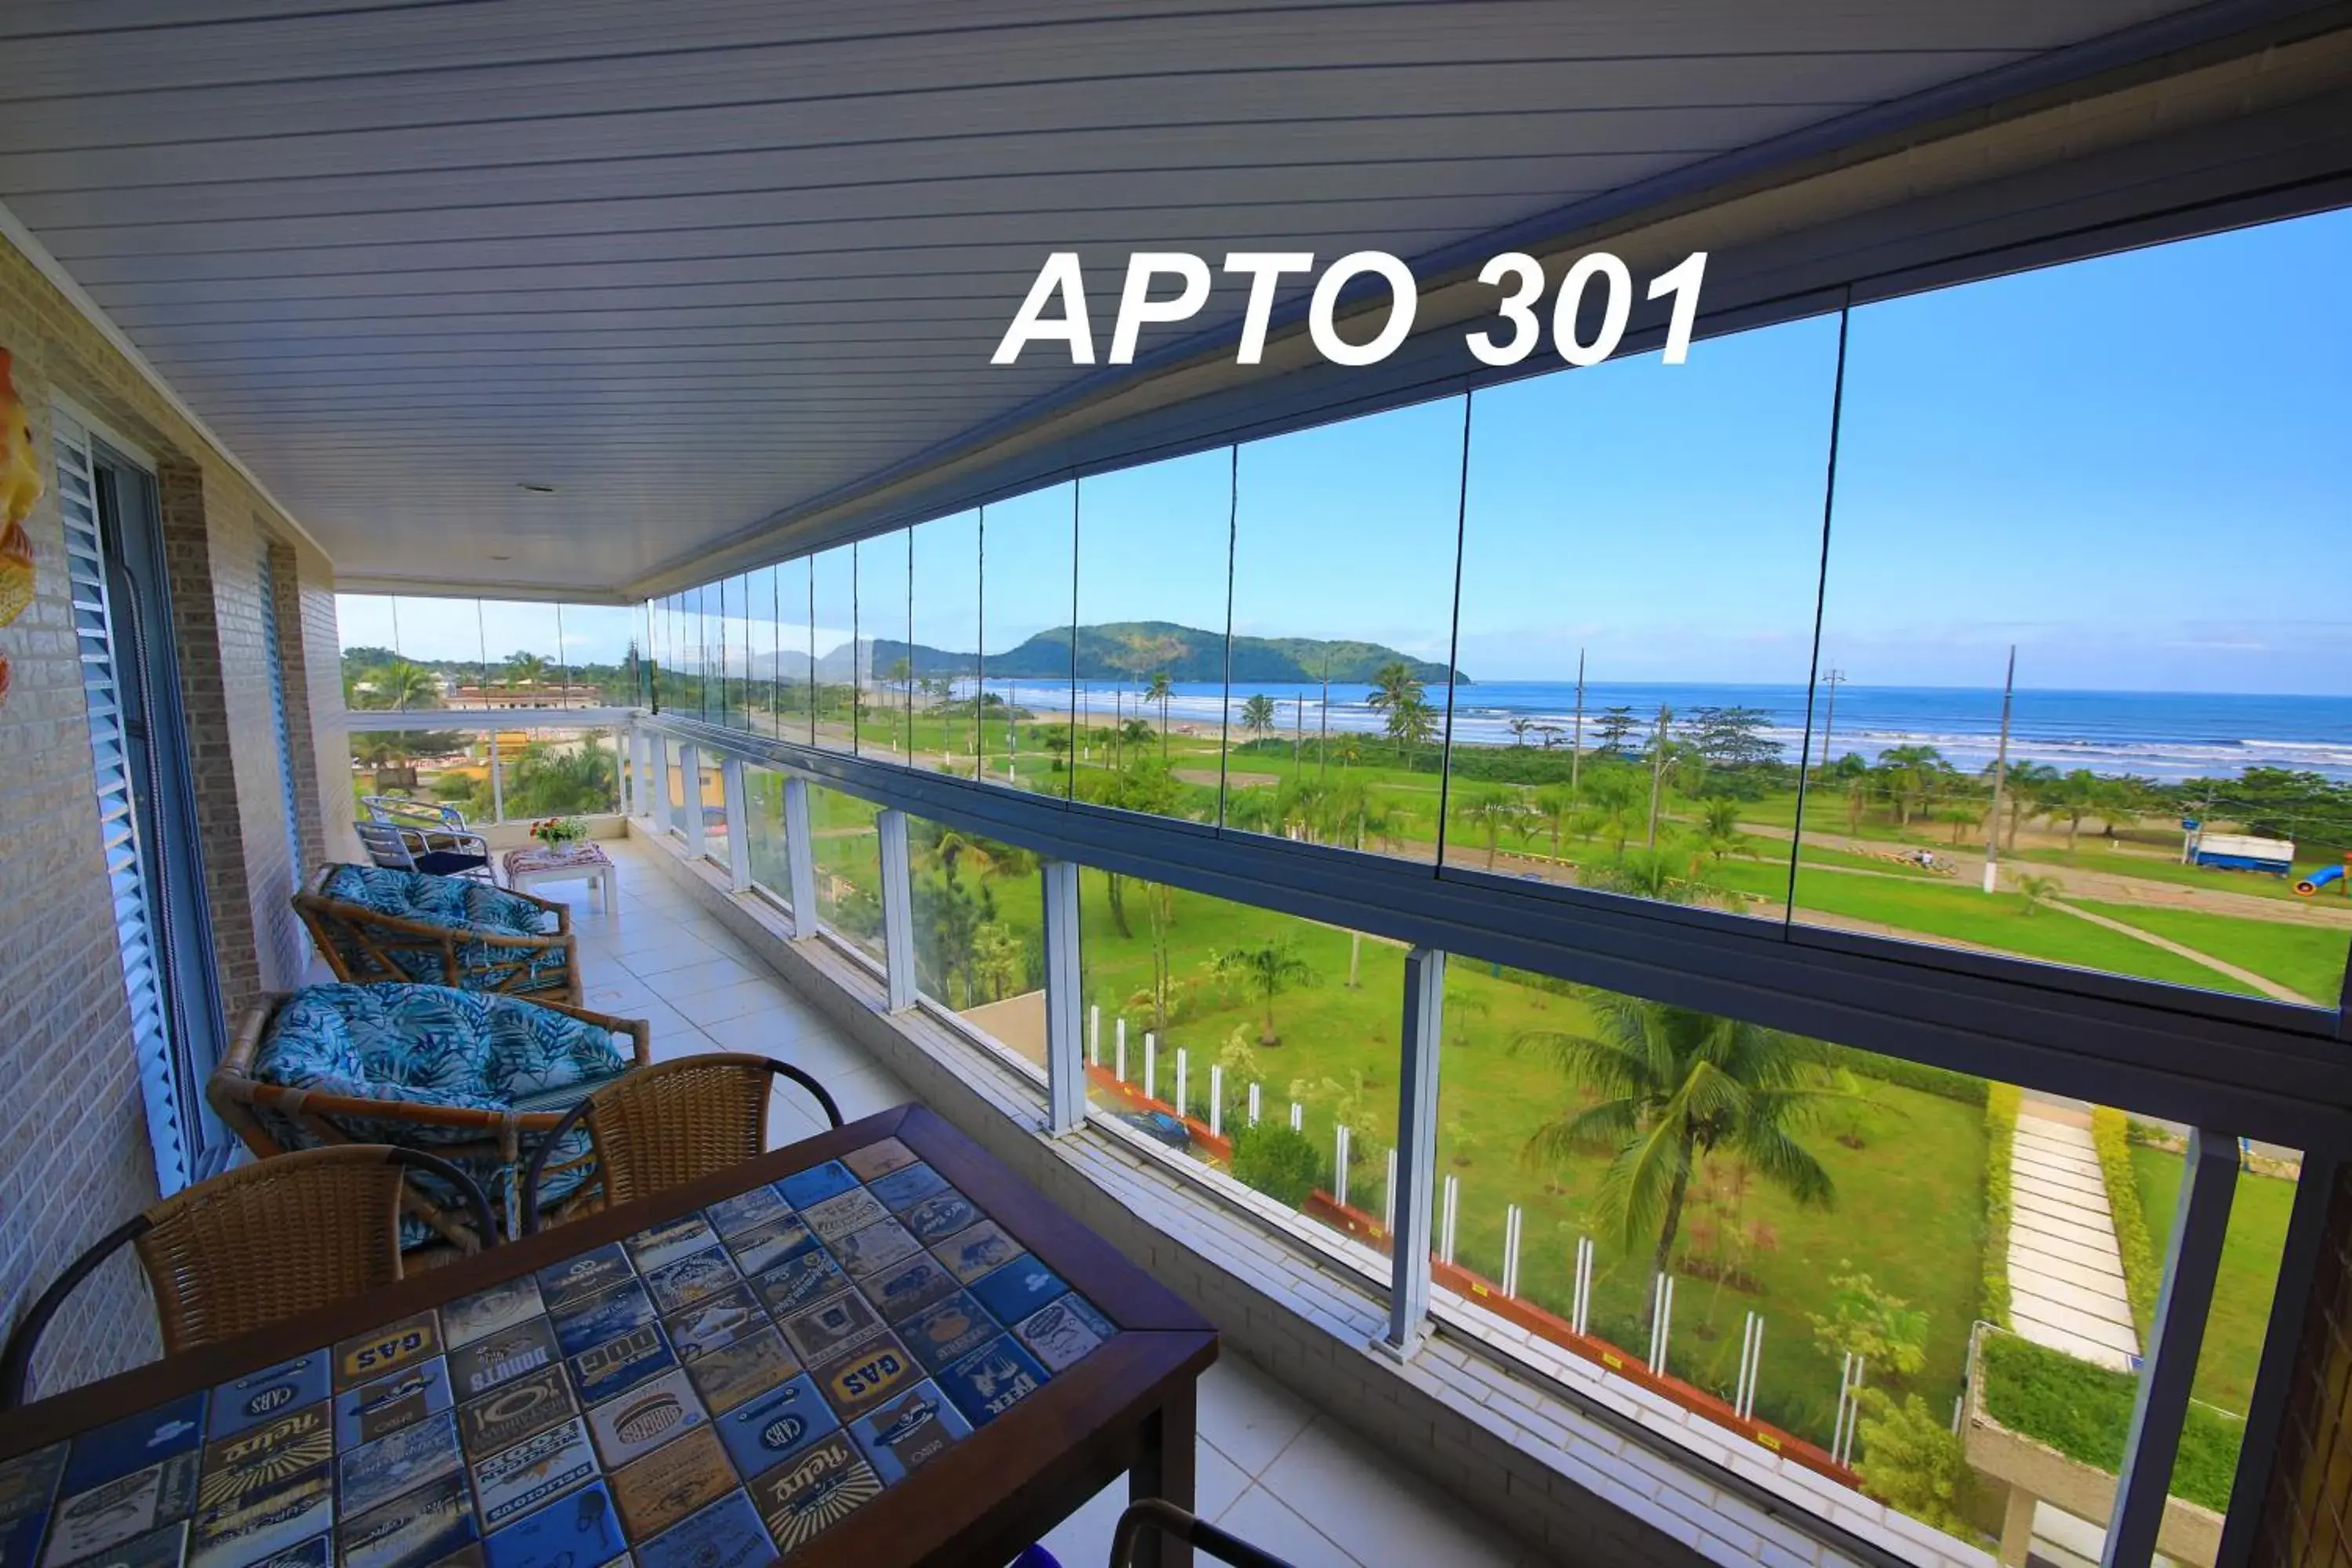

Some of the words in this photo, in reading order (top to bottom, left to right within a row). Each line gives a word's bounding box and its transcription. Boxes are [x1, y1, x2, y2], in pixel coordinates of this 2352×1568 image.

[357, 1330, 421, 1371] GAS
[467, 1343, 550, 1396] DONUTS
[576, 1324, 659, 1378] DOG
[840, 1352, 902, 1397] GAS
[248, 1385, 294, 1413] CARS
[619, 1406, 681, 1444] BURGERS
[220, 1413, 319, 1465] Retro
[480, 1428, 579, 1485] MEXICAN
[764, 1417, 801, 1446] CARS
[488, 1462, 589, 1524] DELICIOUS
[767, 1450, 846, 1504] Retro
